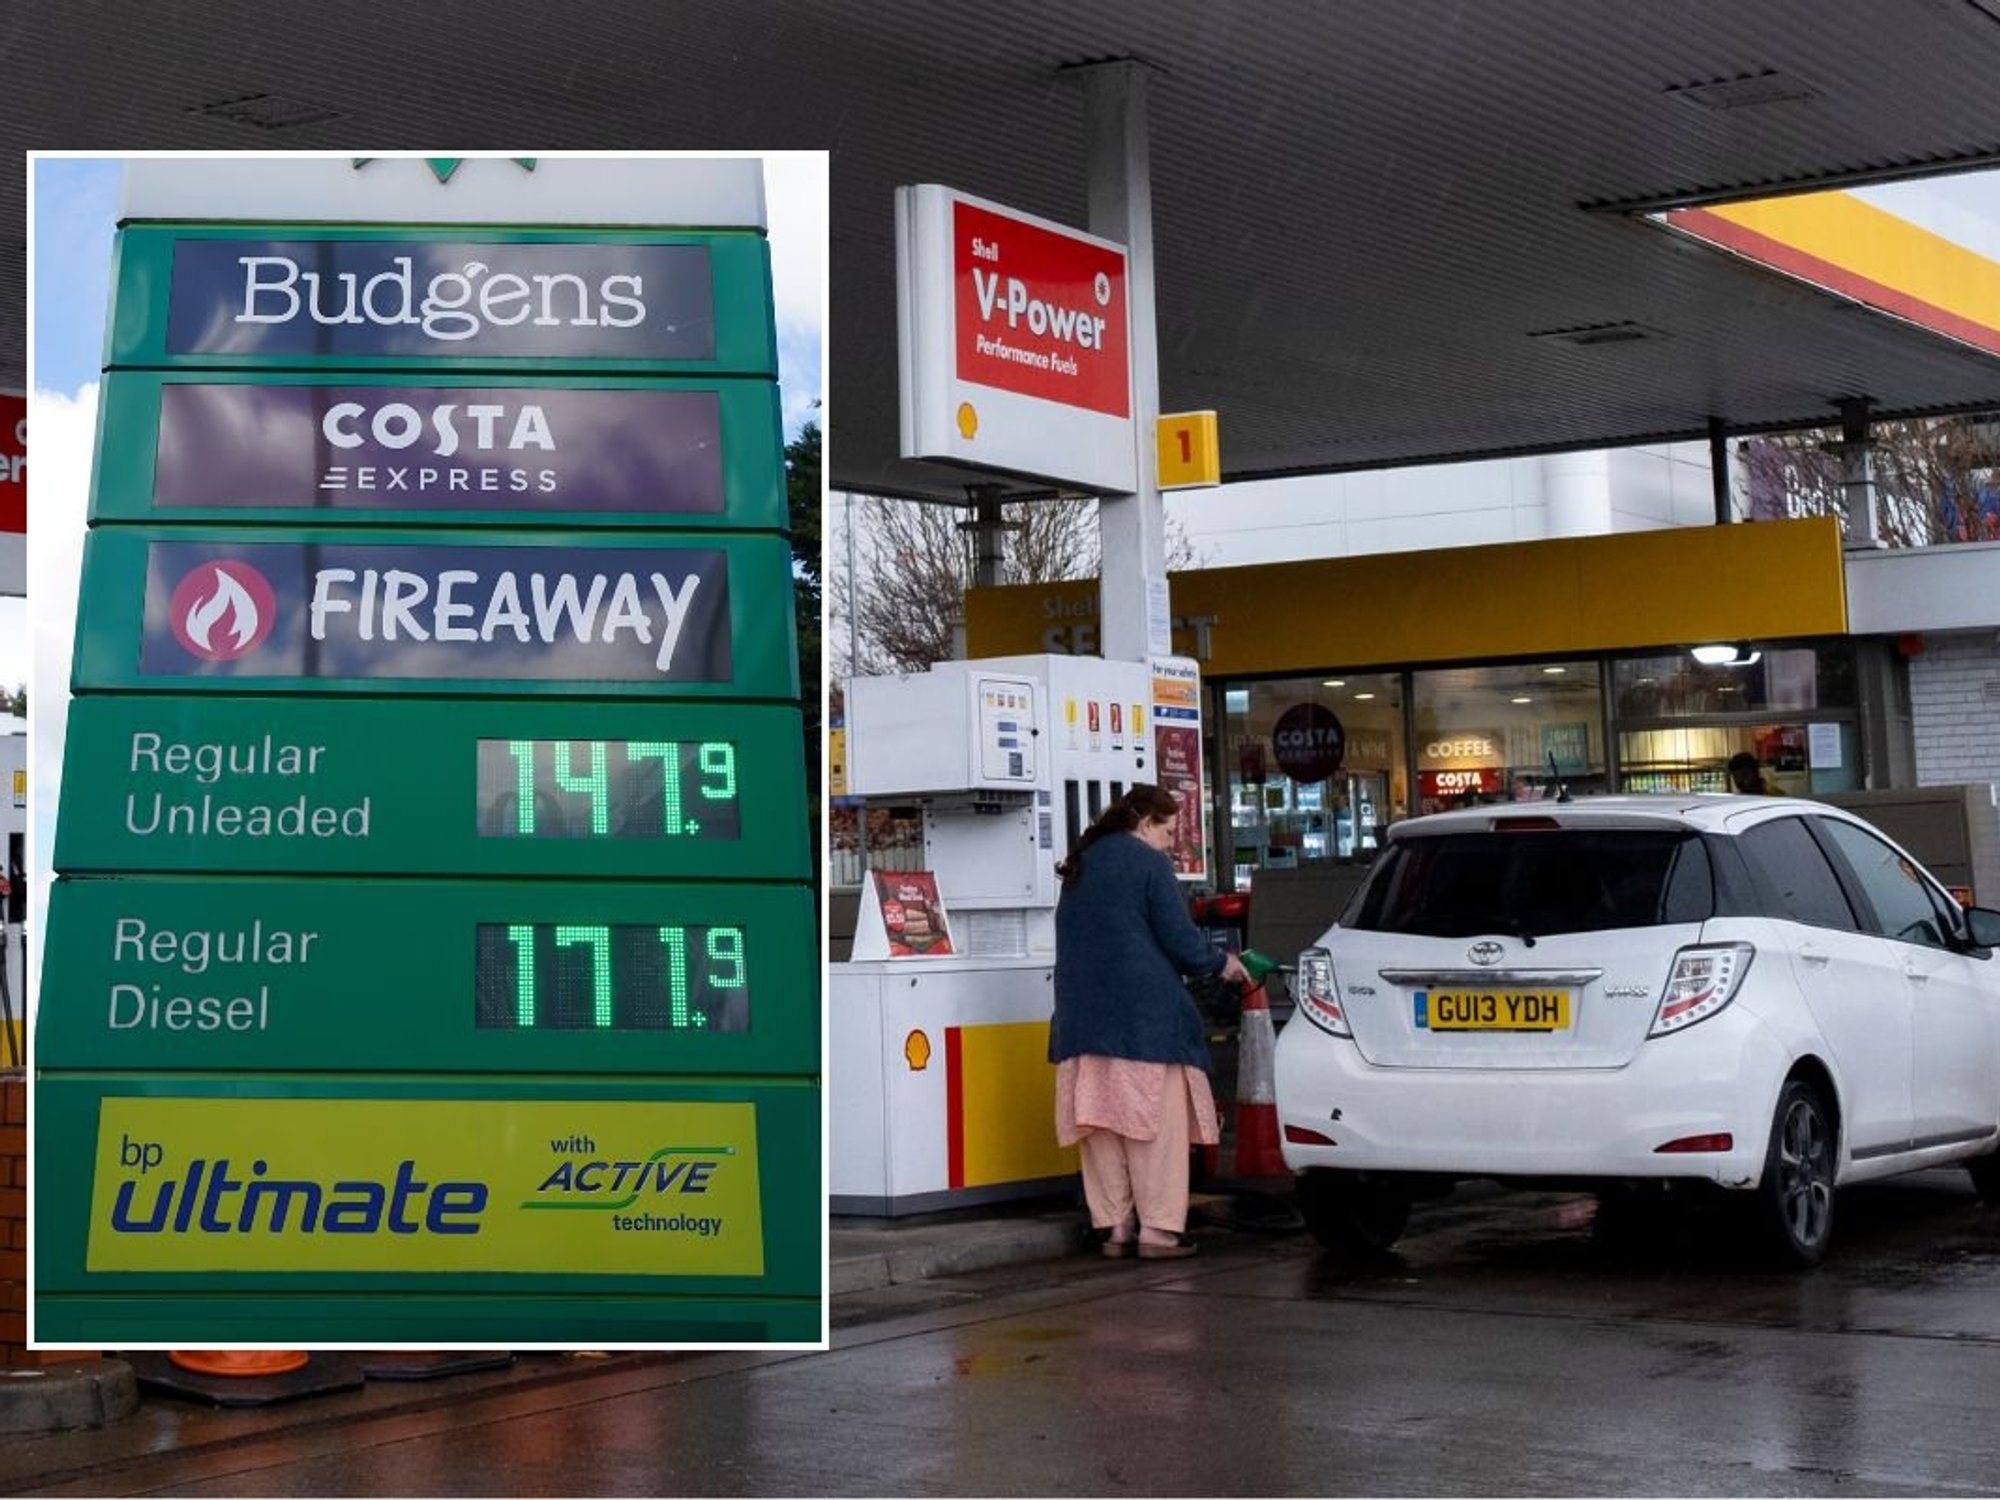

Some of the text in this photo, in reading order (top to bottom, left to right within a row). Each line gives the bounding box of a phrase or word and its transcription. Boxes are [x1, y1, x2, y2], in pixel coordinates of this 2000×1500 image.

[971, 238, 998, 262] Shell
[234, 256, 647, 341] Budgens
[972, 267, 1106, 350] V-Power
[976, 333, 1078, 377] Performance Fuels
[321, 402, 557, 458] COSTA
[1176, 429, 1191, 464] 1
[358, 467, 558, 492] EXPRESS
[309, 569, 701, 672] FIREAWAY
[129, 732, 327, 783] Regular
[1276, 728, 1340, 748] COSTA
[1426, 739, 1493, 759] COFFEE
[1435, 772, 1483, 788] COSTA
[124, 796, 371, 837] Unleaded
[113, 918, 319, 975] Regular
[107, 986, 269, 1031] Diesel
[1437, 995, 1559, 1023] GU13 YDH
[121, 1134, 163, 1174] bp
[550, 1135, 596, 1154] with
[109, 1158, 489, 1236] ultimate
[536, 1161, 718, 1194] ACTIVE
[612, 1212, 722, 1237] technology
